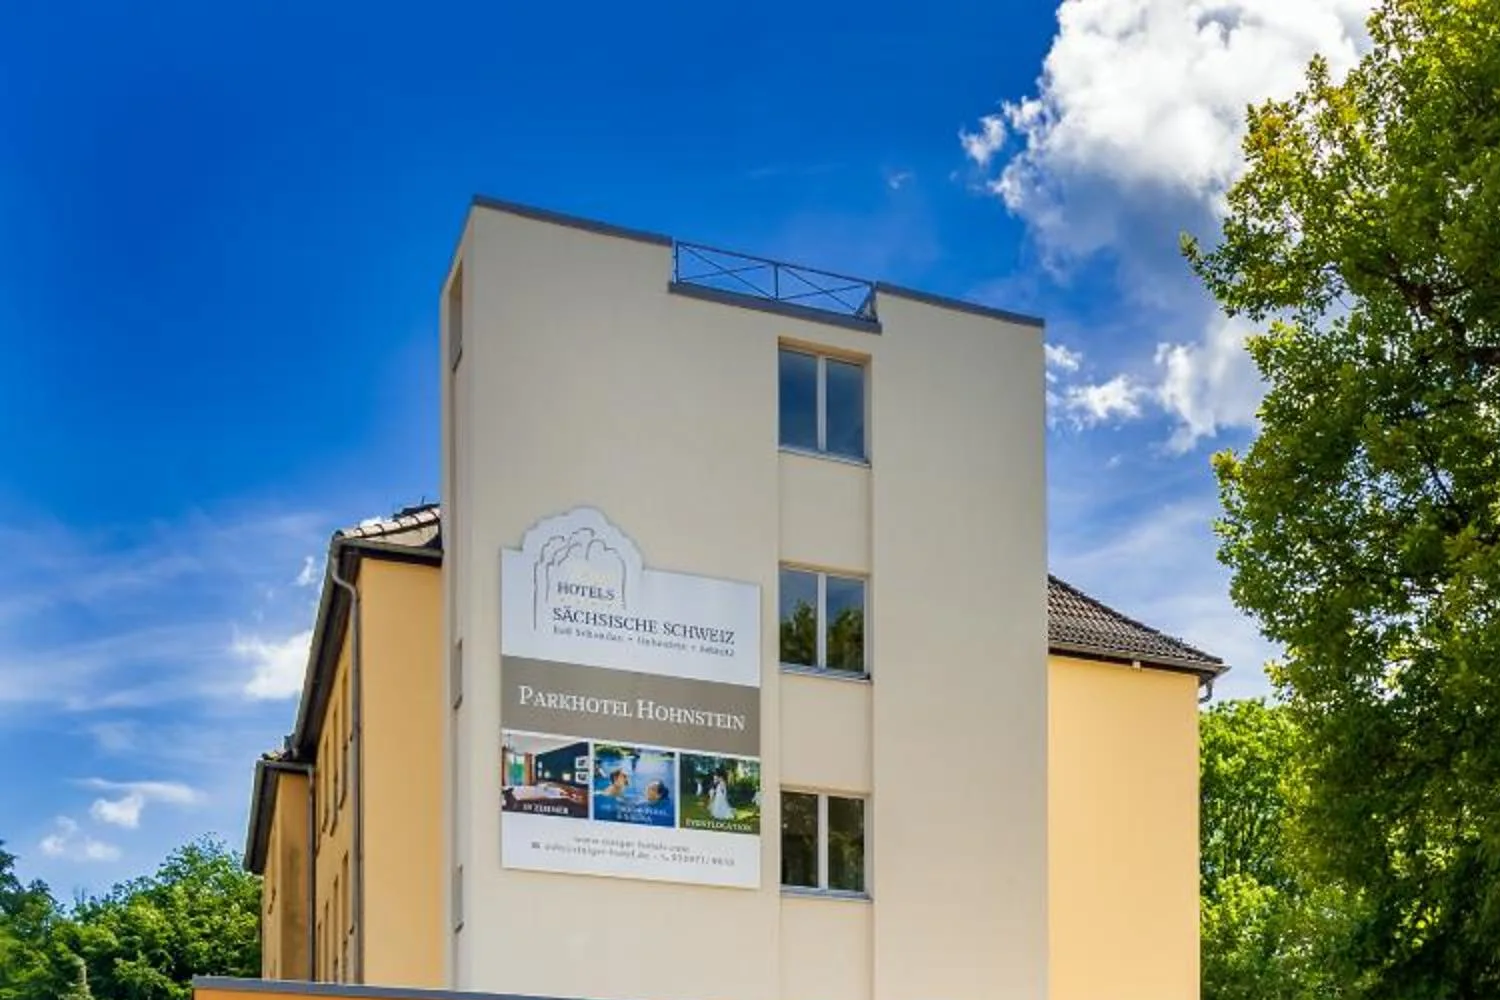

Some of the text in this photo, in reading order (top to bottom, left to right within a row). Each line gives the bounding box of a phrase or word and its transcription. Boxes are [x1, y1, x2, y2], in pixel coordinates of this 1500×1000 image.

[557, 581, 615, 601] HOTELS
[553, 605, 658, 635] SÄCHSISCHE
[663, 622, 735, 645] SCHWEIZ
[518, 685, 746, 731] PARKHOTEL HOHNSTEIN
